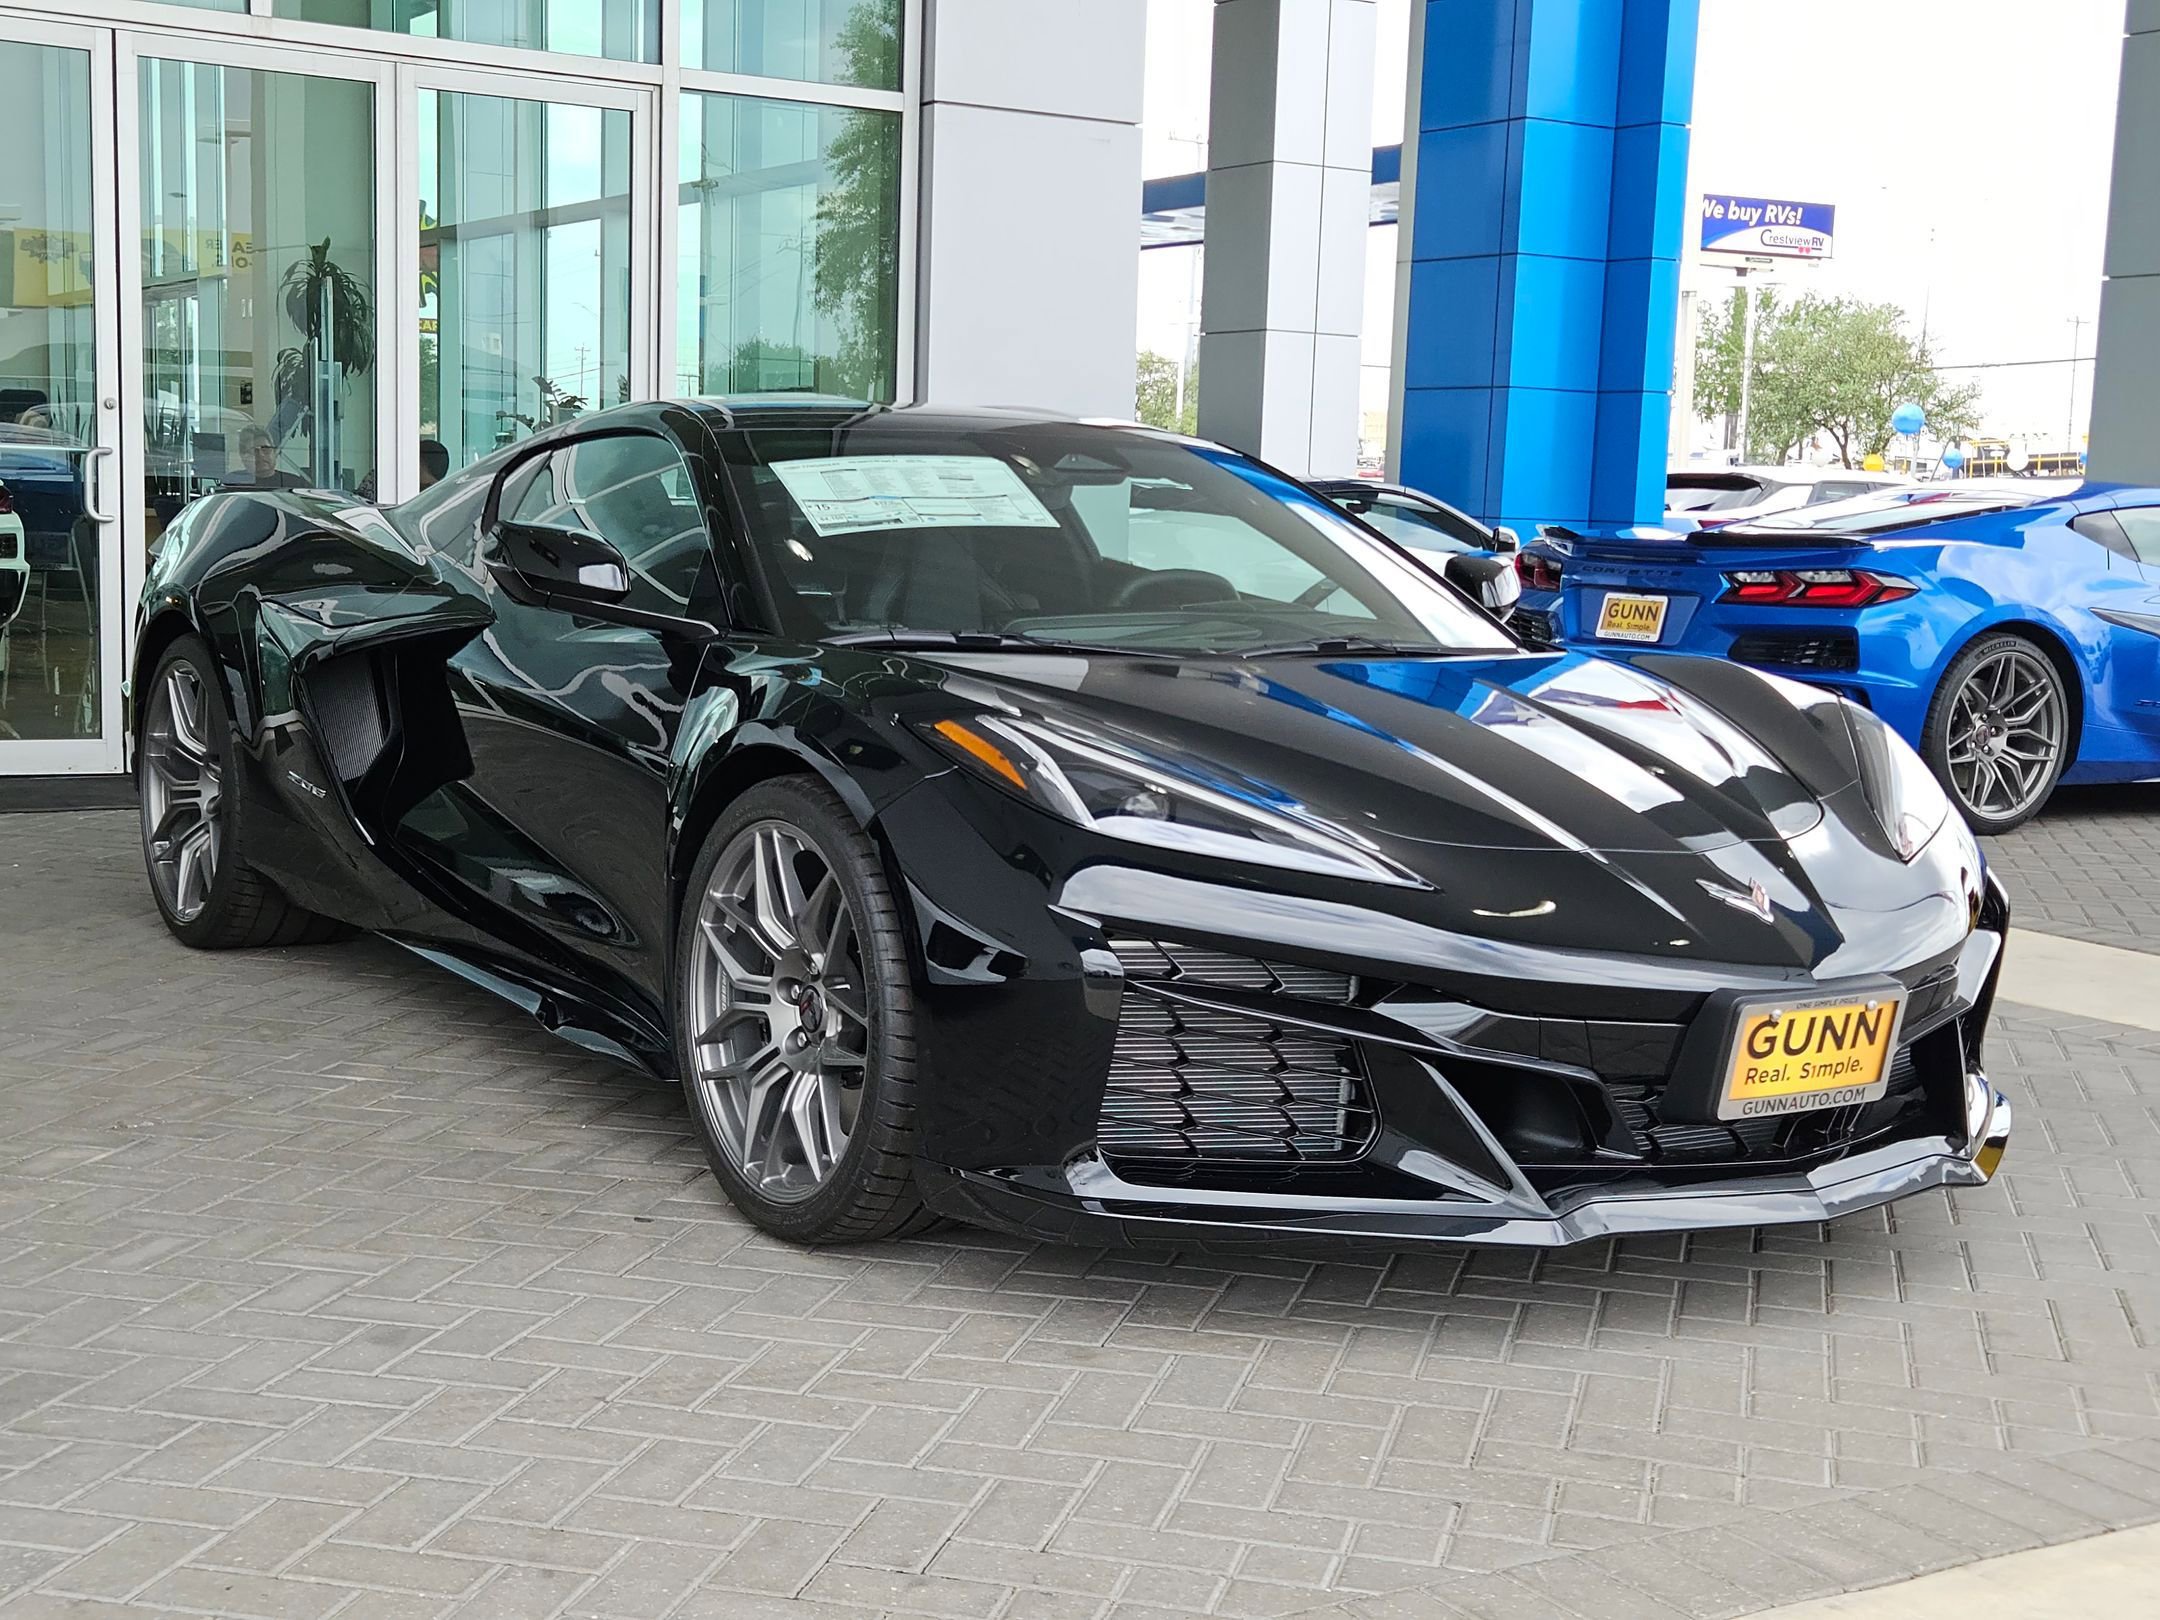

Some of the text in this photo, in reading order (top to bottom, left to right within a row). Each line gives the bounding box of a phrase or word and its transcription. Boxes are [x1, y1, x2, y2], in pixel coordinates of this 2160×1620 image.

[1728, 200, 1763, 227] buy
[1764, 203, 1803, 225] RVs!
[1582, 565, 1683, 577] CORVETTE
[1608, 602, 1659, 621] GUNN
[1604, 631, 1651, 641] GUNNAUTO.COM
[1606, 620, 1652, 631] Real. Simple.
[1747, 1008, 1883, 1059] GUNN
[1744, 1056, 1865, 1086] Real. Simple.
[1742, 1088, 1867, 1116] GUNNAUTO.COM
